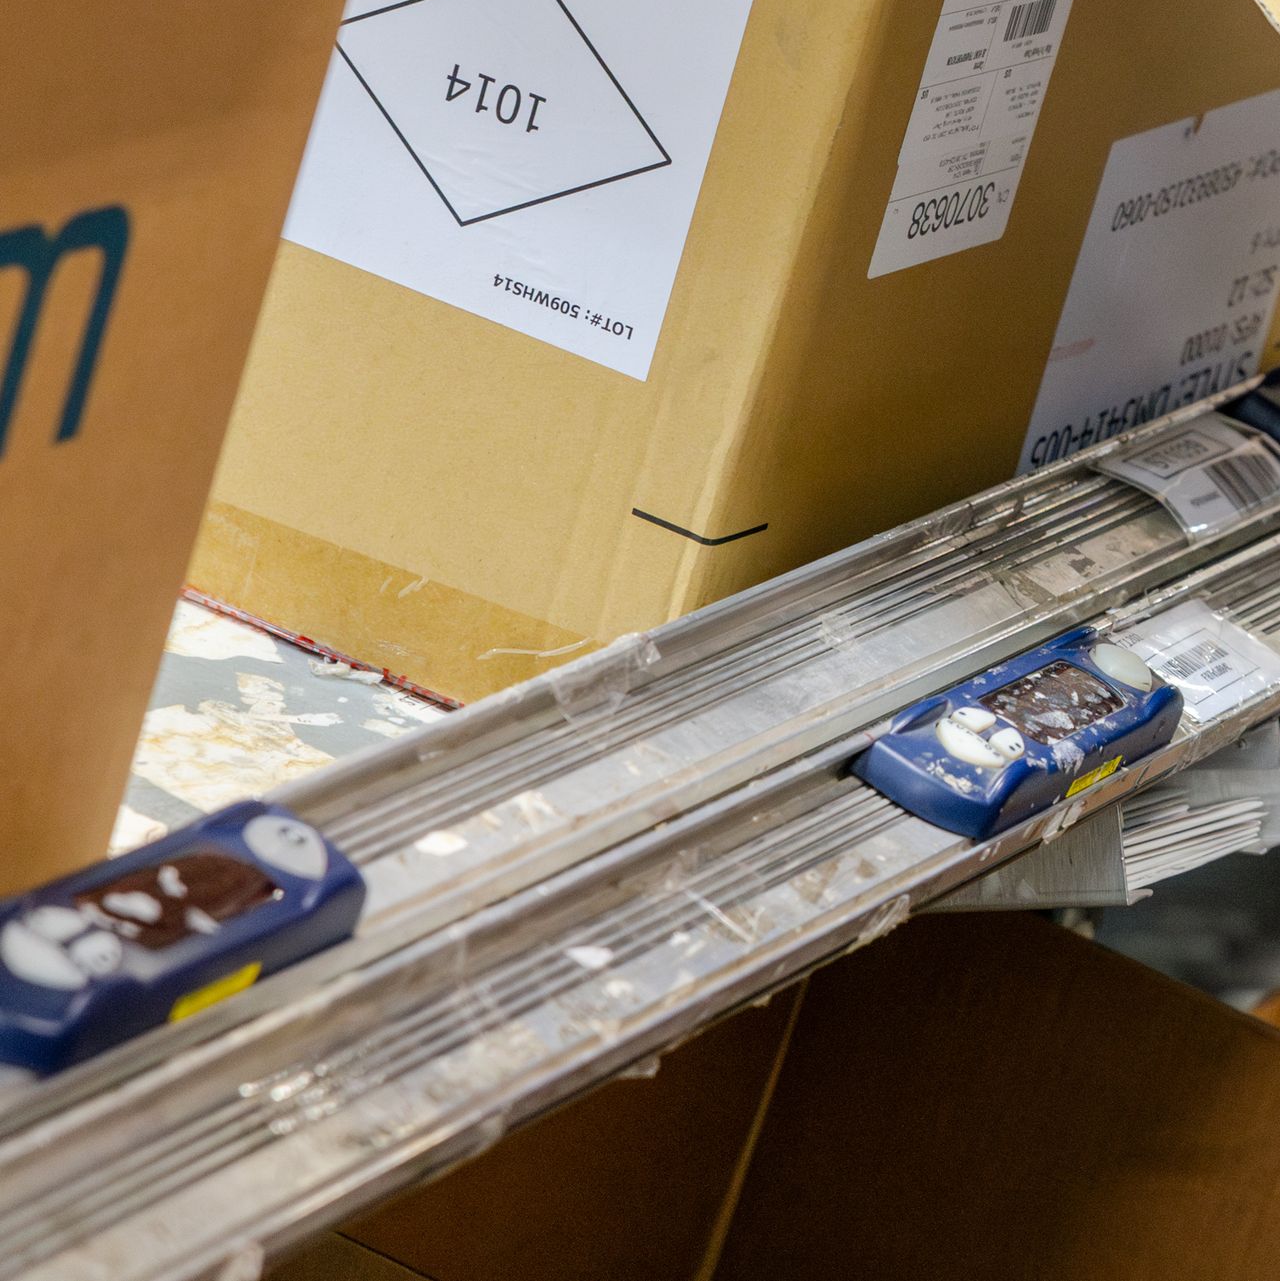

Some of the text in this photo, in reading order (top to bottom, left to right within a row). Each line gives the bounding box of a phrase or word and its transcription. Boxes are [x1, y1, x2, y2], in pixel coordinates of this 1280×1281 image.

[445, 64, 546, 132] 1014
[907, 182, 995, 239] 3070638
[493, 273, 634, 340] LOT#: 509WHS14
